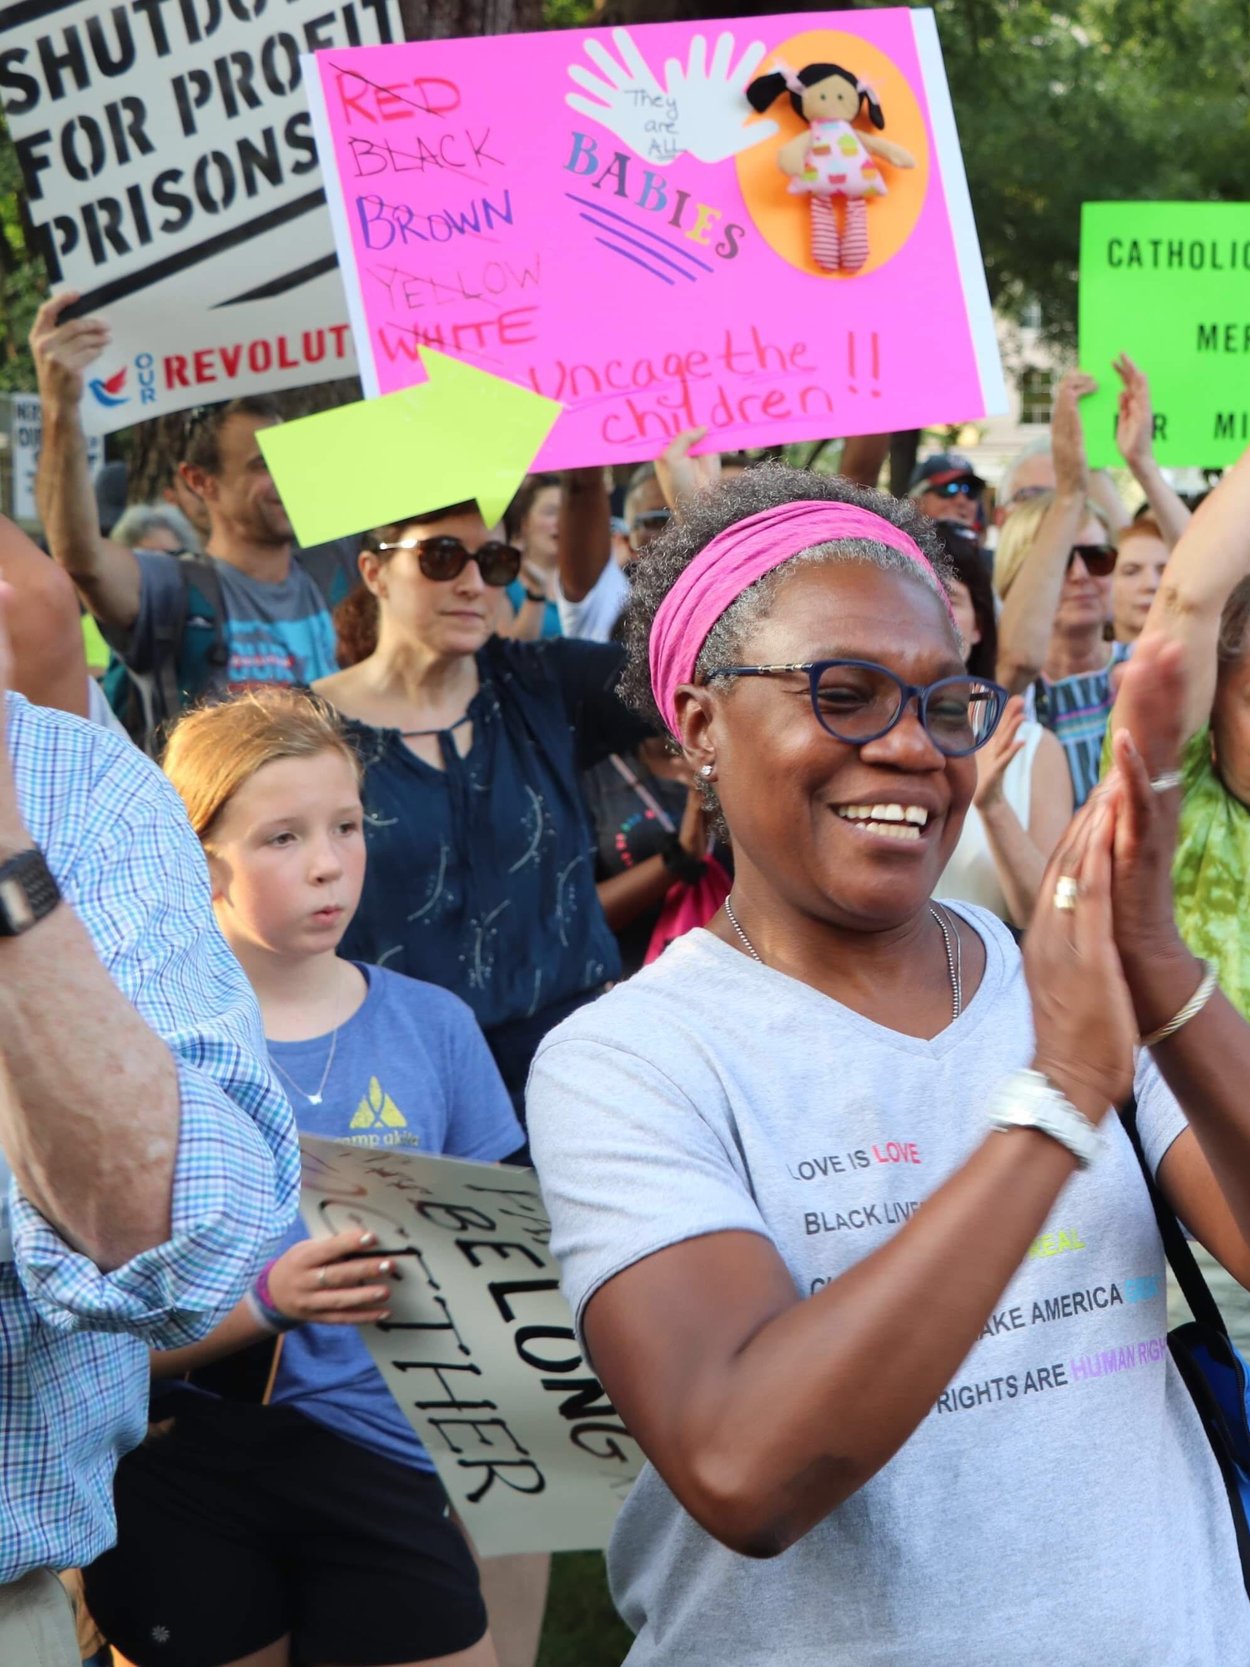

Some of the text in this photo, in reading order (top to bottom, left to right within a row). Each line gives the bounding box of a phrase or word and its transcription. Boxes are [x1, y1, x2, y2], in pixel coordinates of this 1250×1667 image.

[336, 70, 461, 125] RED
[624, 88, 679, 120] They
[14, 97, 155, 201] FOR
[347, 127, 505, 178] BLACK
[644, 119, 679, 134] are
[30, 111, 320, 284] PRISONS
[355, 189, 513, 250] BROWN
[563, 131, 746, 260] BABIES
[366, 252, 541, 310] YELLOW
[378, 306, 540, 362] WHITE
[718, 326, 818, 376] the
[134, 352, 156, 404] OUR
[602, 384, 833, 444] children
[848, 1149, 871, 1170] IS
[872, 1141, 922, 1164] LOVE
[804, 1204, 882, 1236] BLACK
[976, 1306, 1026, 1341] AKE
[1031, 1283, 1124, 1325] AMERICA
[936, 1374, 1018, 1414] RIGHTS
[1023, 1363, 1068, 1395] ARE
[1070, 1342, 1135, 1382] HUMAN
